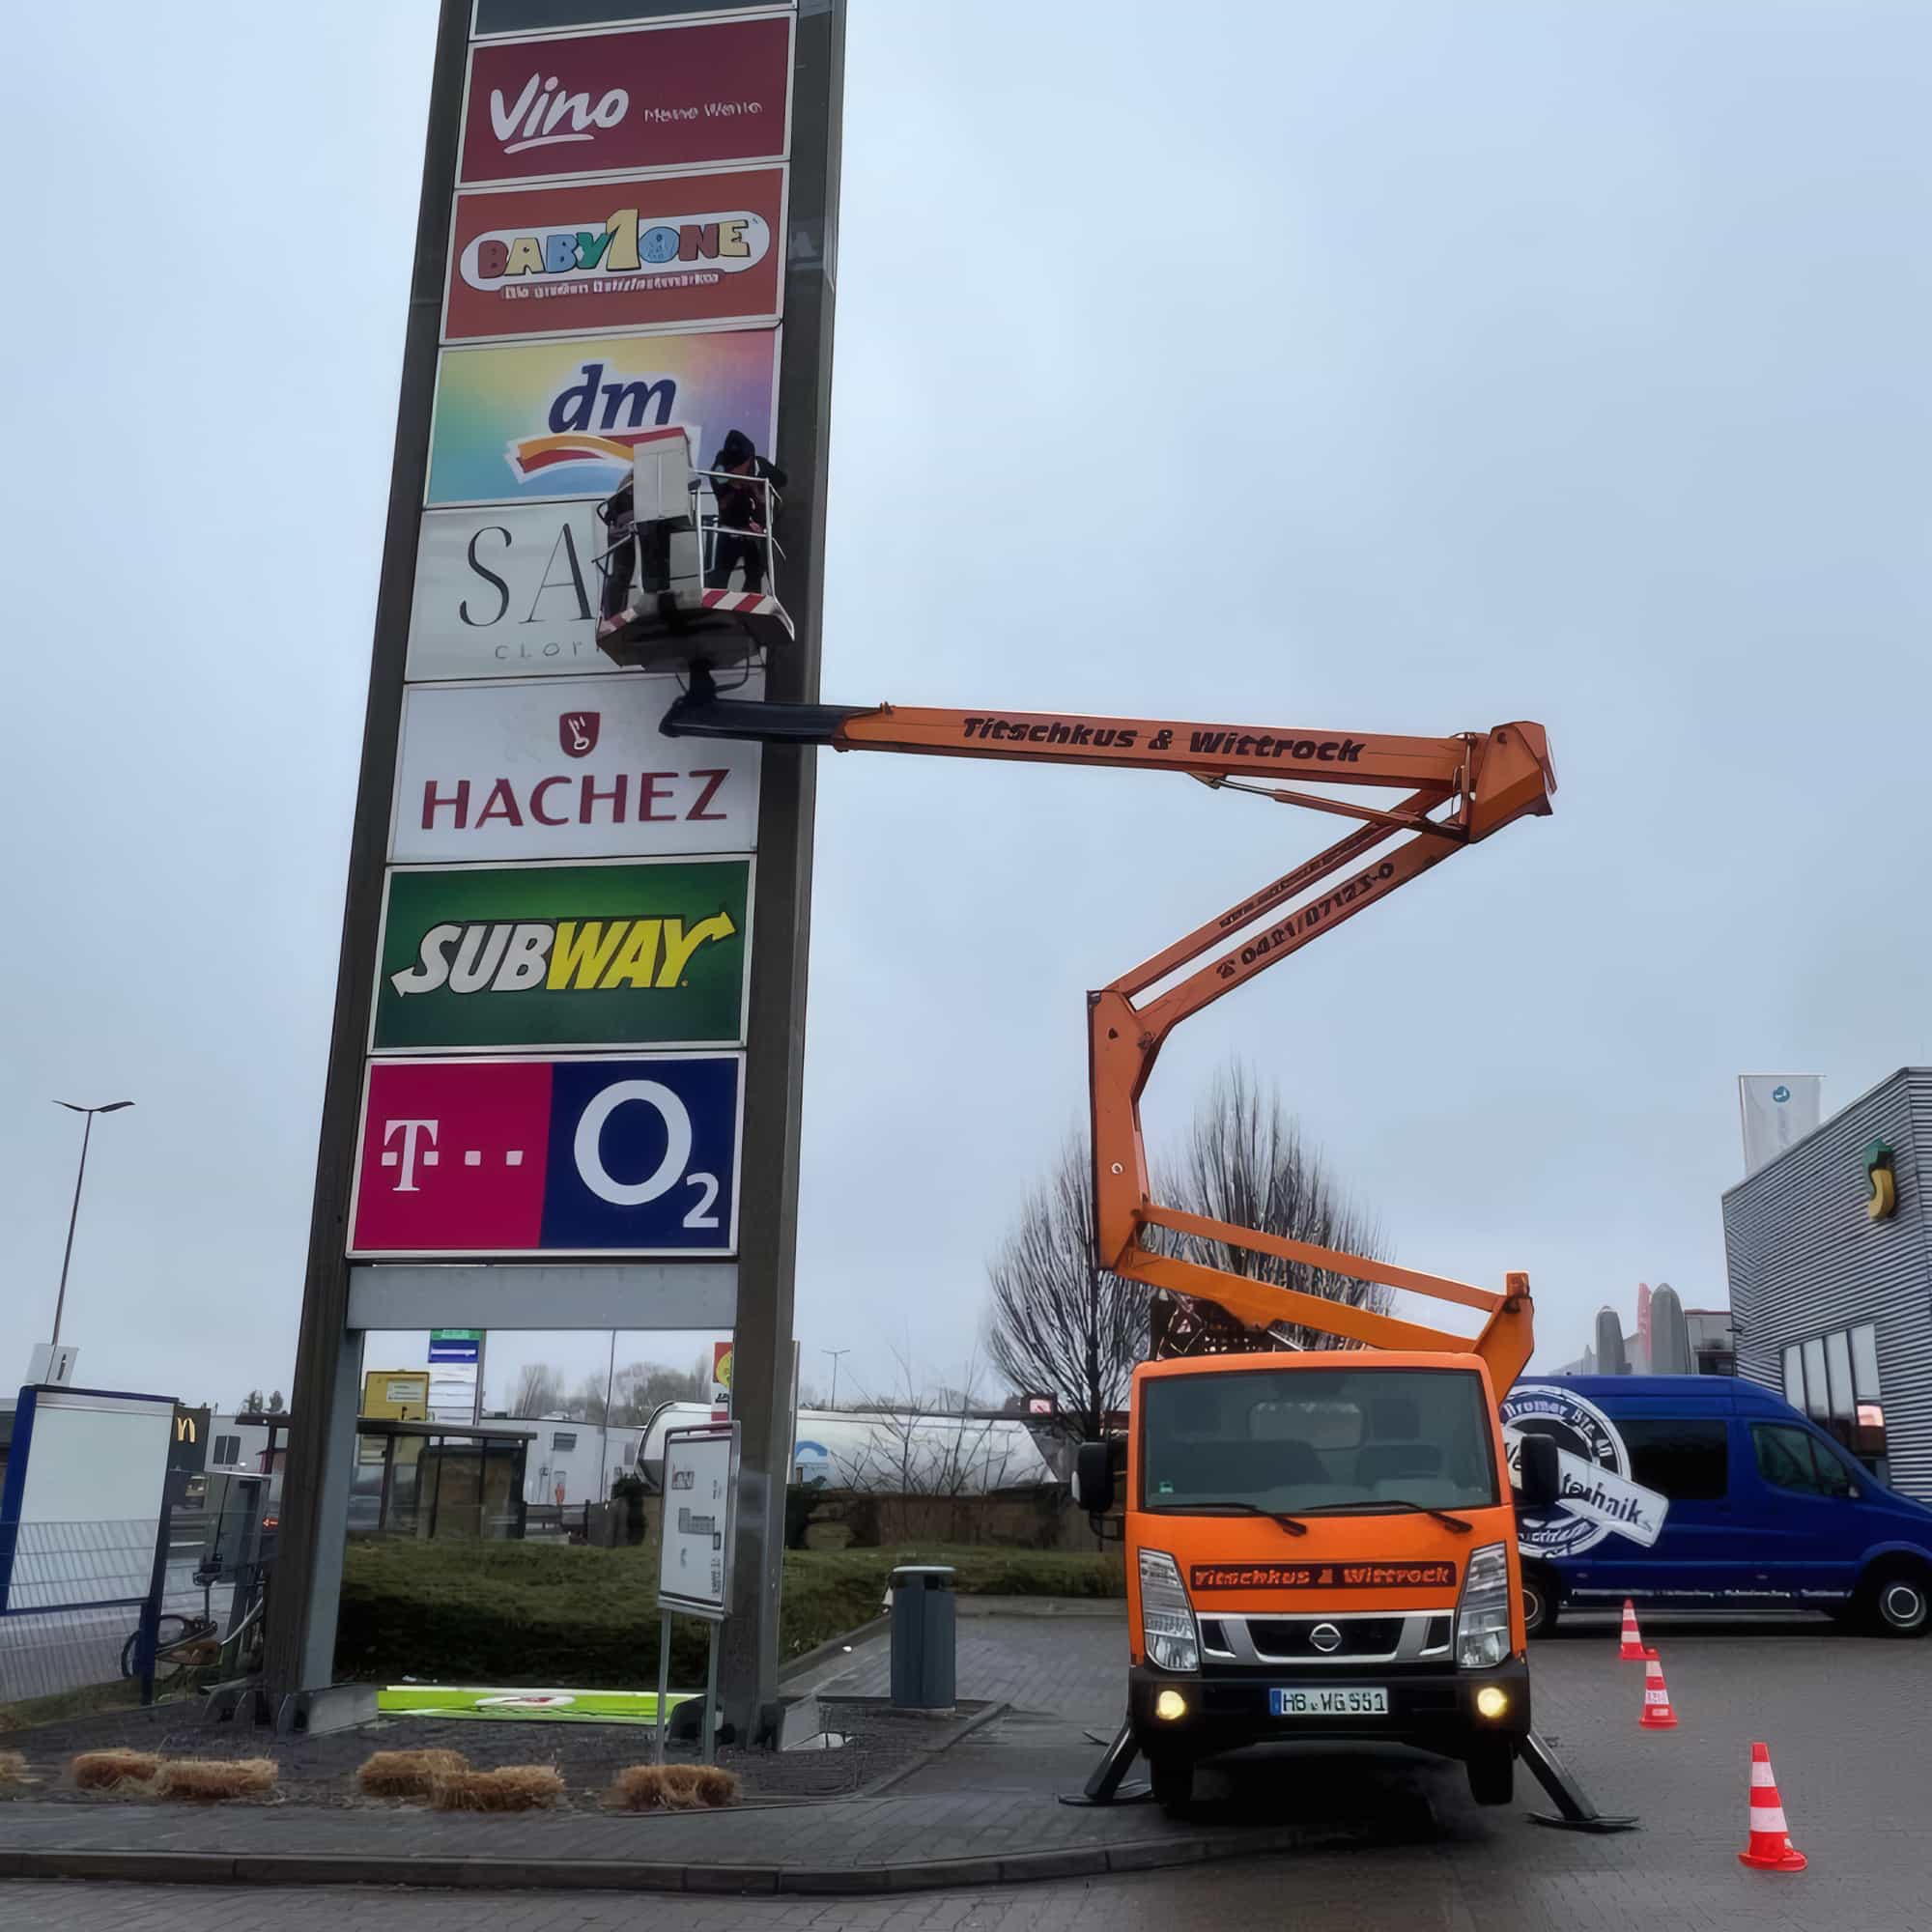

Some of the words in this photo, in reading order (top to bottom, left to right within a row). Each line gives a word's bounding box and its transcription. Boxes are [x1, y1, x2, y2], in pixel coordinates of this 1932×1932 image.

[490, 72, 629, 142] Vino
[548, 363, 677, 435] dm
[459, 523, 599, 628] SA
[963, 717, 1138, 749] Titschkus
[1148, 729, 1174, 751] &
[1190, 731, 1367, 763] Wittrock
[421, 769, 730, 830] HACHEZ
[390, 911, 736, 997] SUBWAY
[574, 1079, 720, 1228] O2
[1343, 1566, 1450, 1585] Wittrock
[1283, 1692, 1307, 1712] HB
